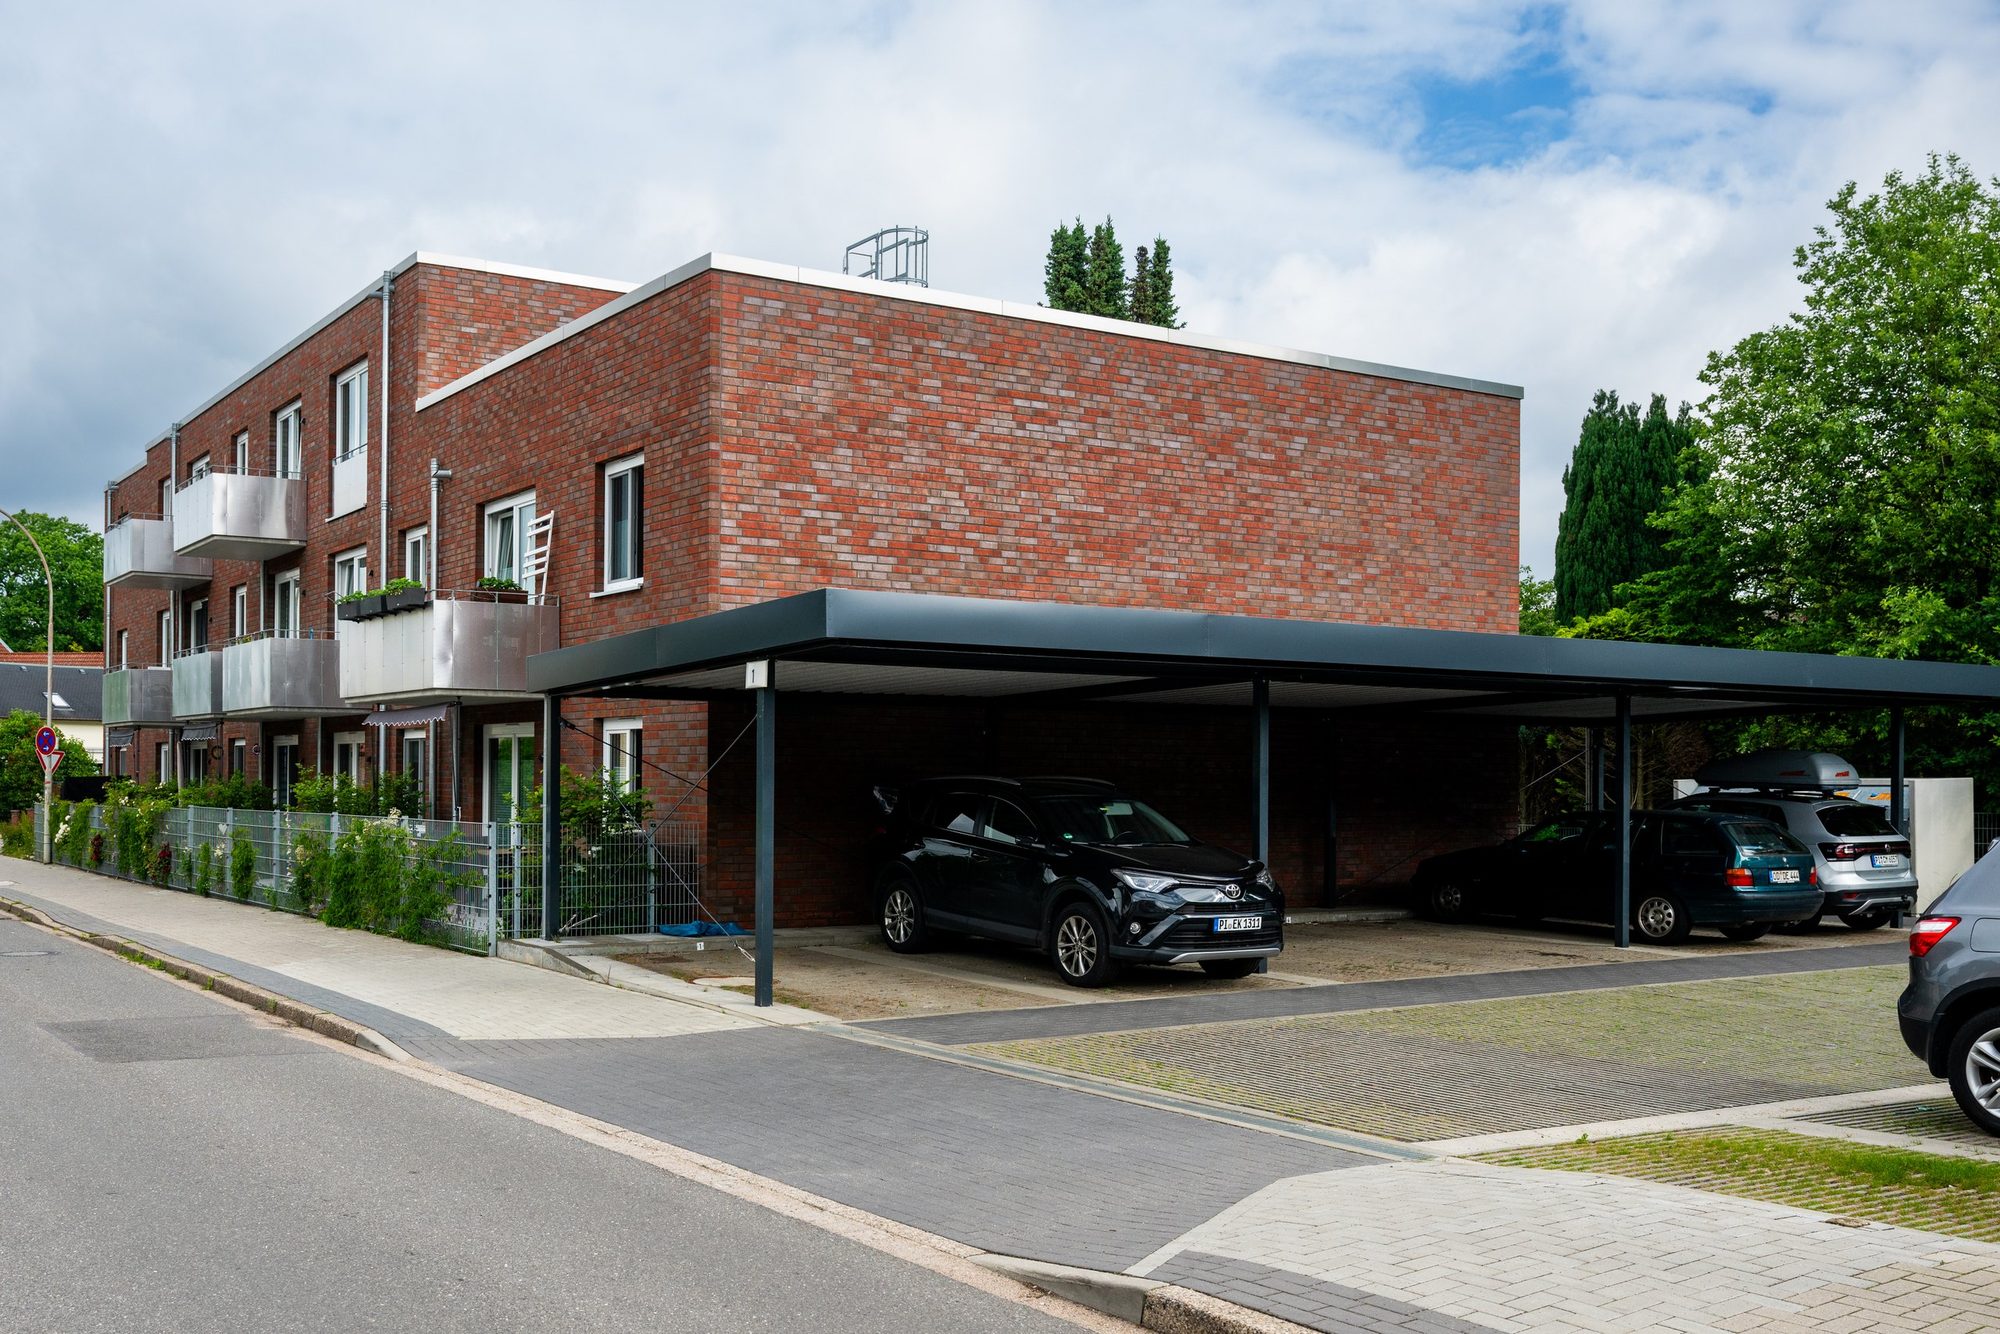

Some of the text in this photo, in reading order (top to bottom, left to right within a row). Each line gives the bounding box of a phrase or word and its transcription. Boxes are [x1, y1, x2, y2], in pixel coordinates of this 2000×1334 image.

[1219, 918, 1260, 930] PI EK 1311
